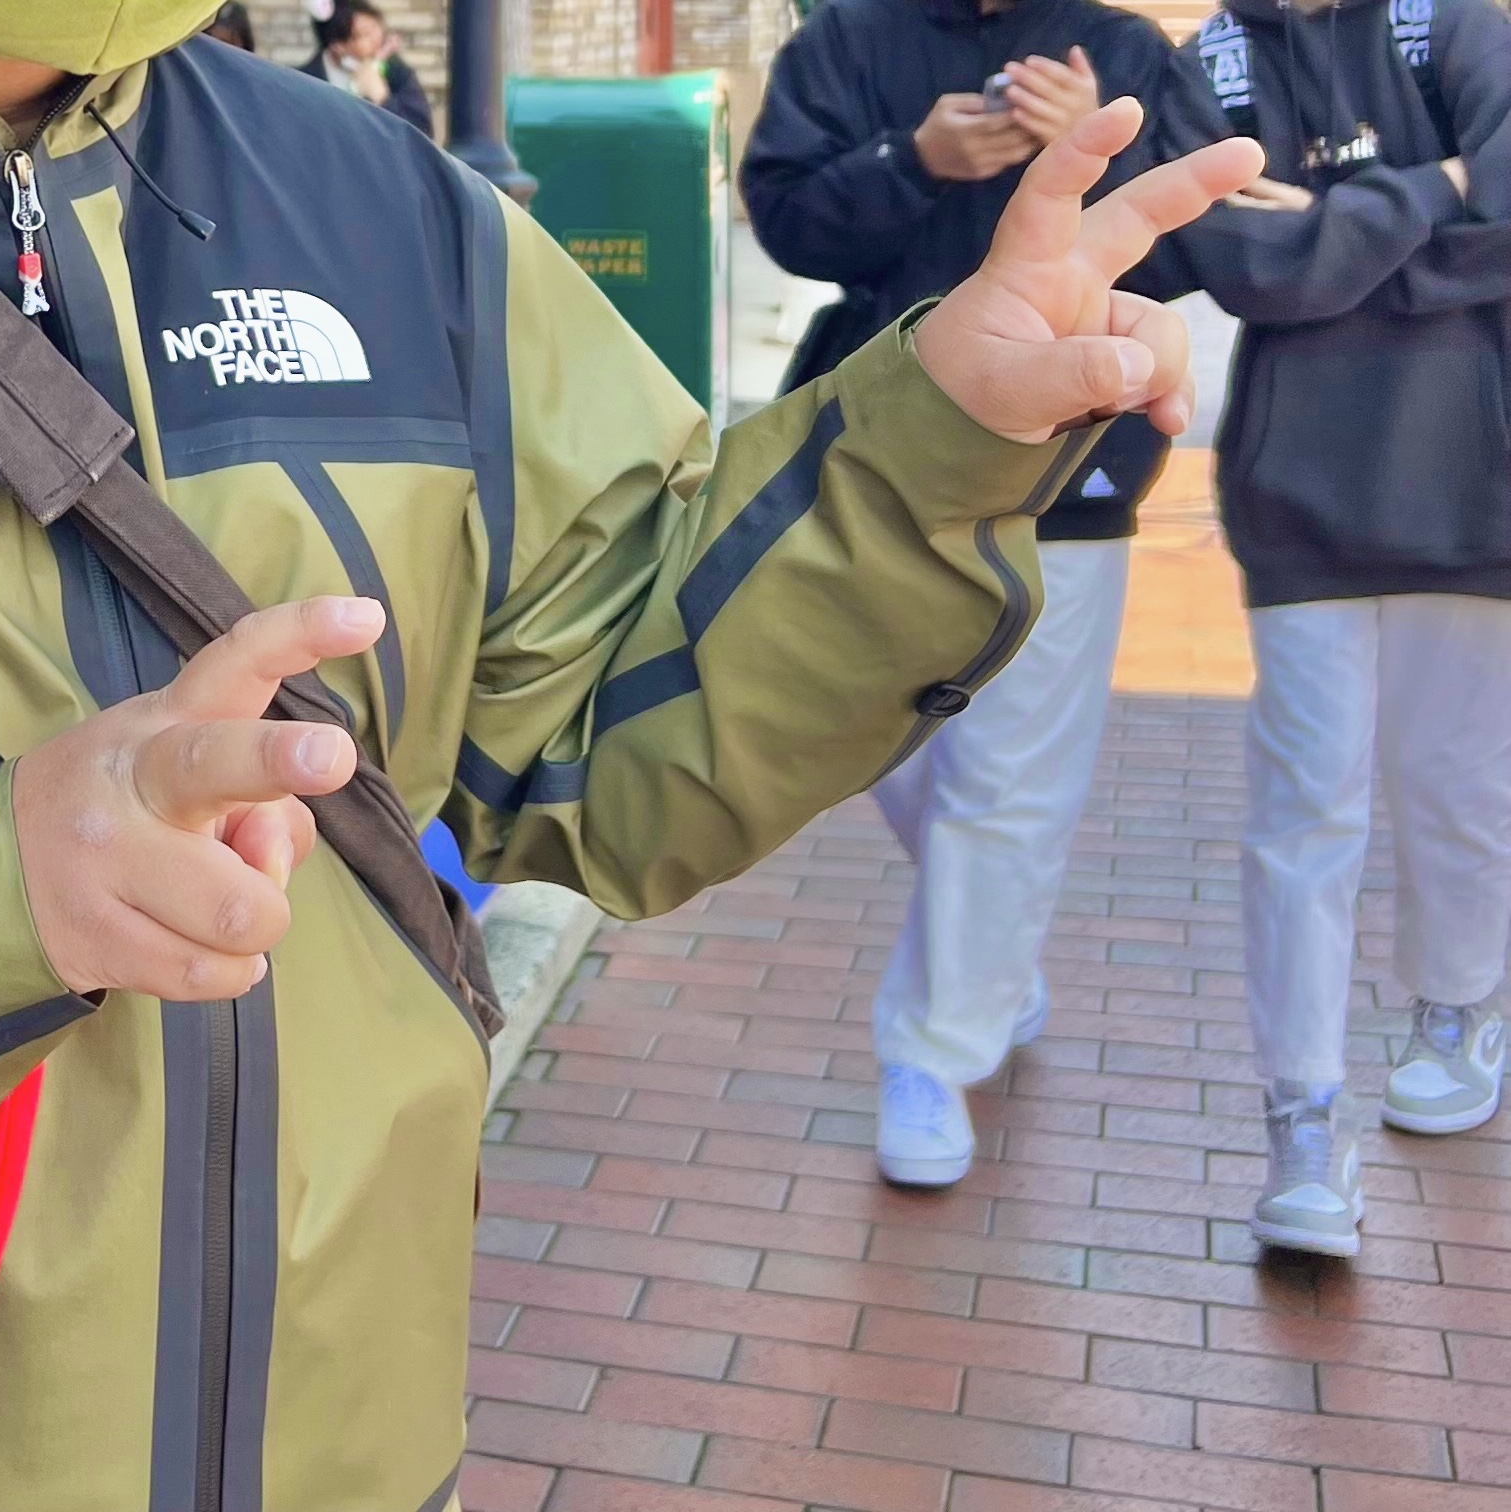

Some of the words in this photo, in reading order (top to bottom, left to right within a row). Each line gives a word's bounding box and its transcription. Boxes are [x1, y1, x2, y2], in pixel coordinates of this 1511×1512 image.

[569, 239, 643, 255] WASTE
[576, 258, 642, 275] APER
[212, 289, 288, 320] THE
[162, 320, 297, 362] NORTH
[210, 349, 305, 387] FACE
